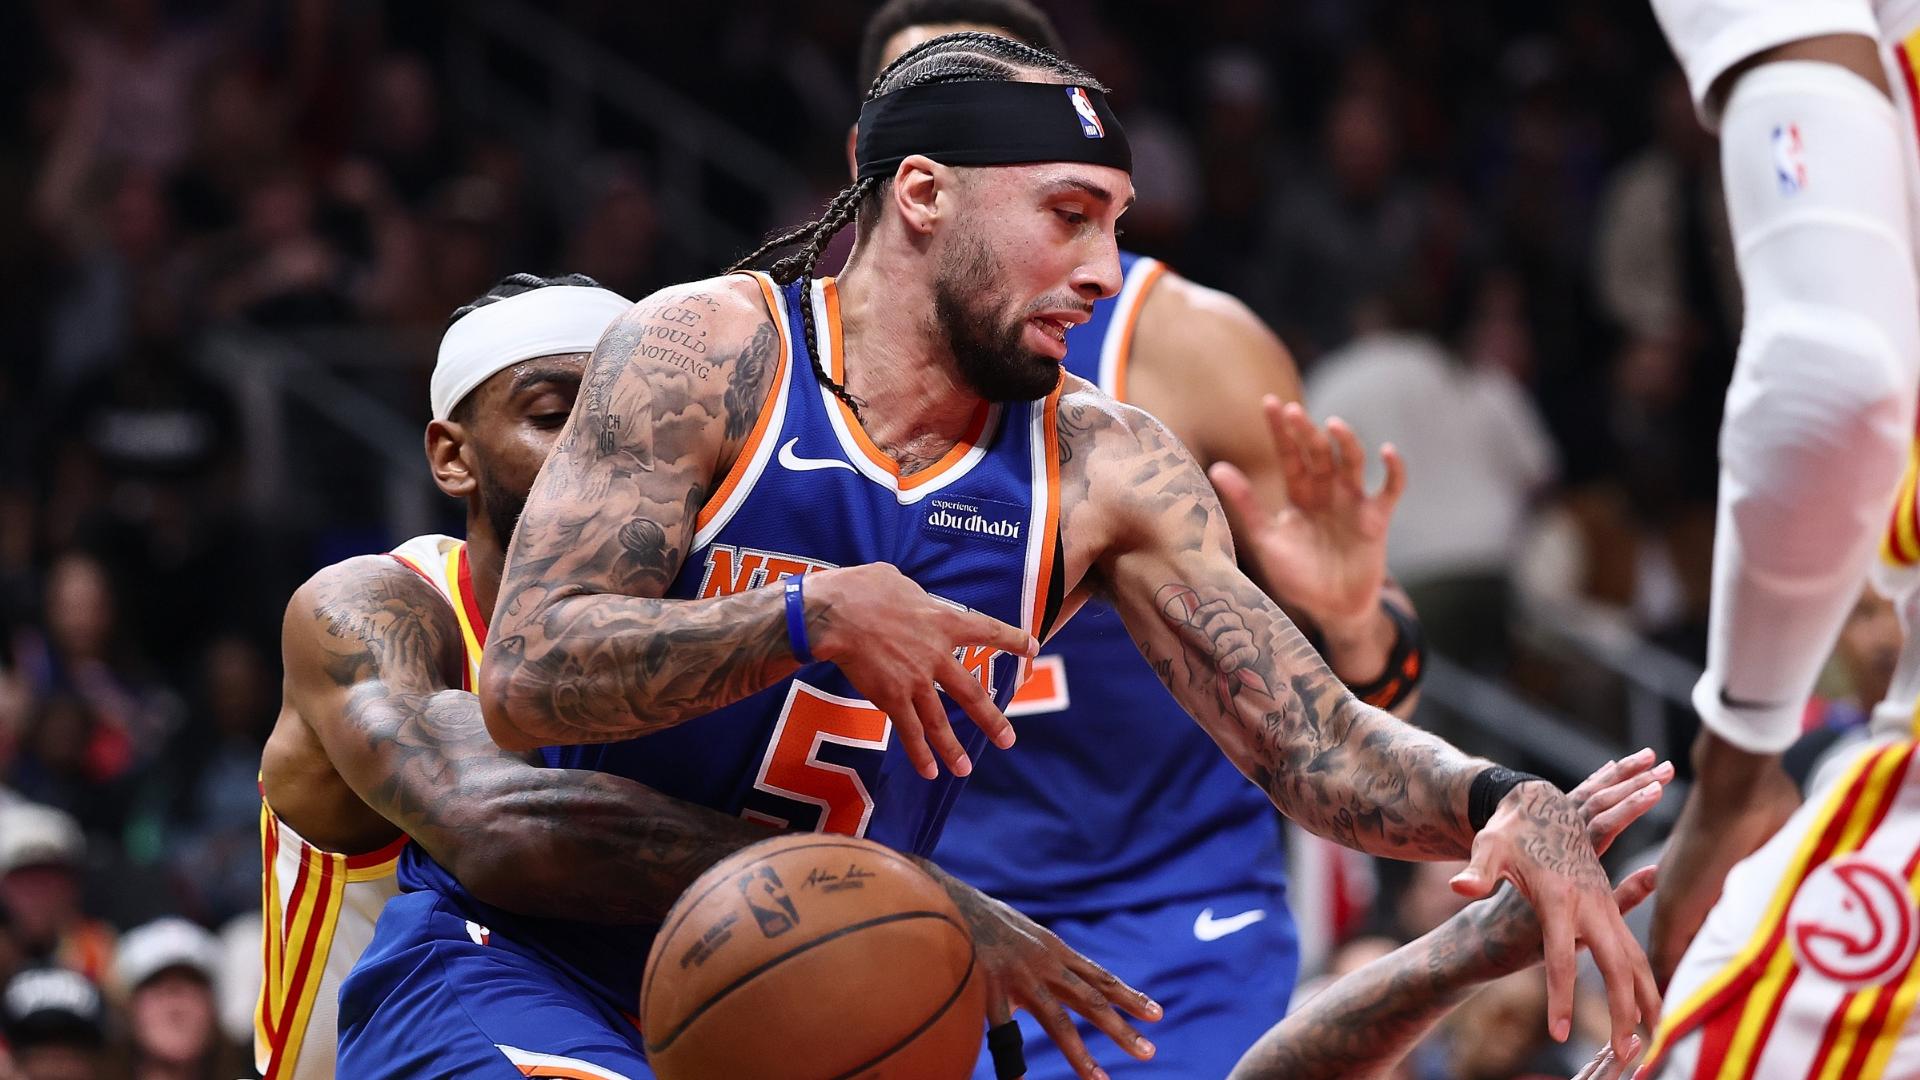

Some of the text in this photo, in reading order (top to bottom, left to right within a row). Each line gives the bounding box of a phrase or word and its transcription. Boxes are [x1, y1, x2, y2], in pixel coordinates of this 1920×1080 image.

[642, 325, 707, 354] WOULD
[636, 343, 710, 381] NOTHING.
[928, 509, 962, 530] abu
[931, 499, 979, 513] experience
[741, 678, 893, 839] 5
